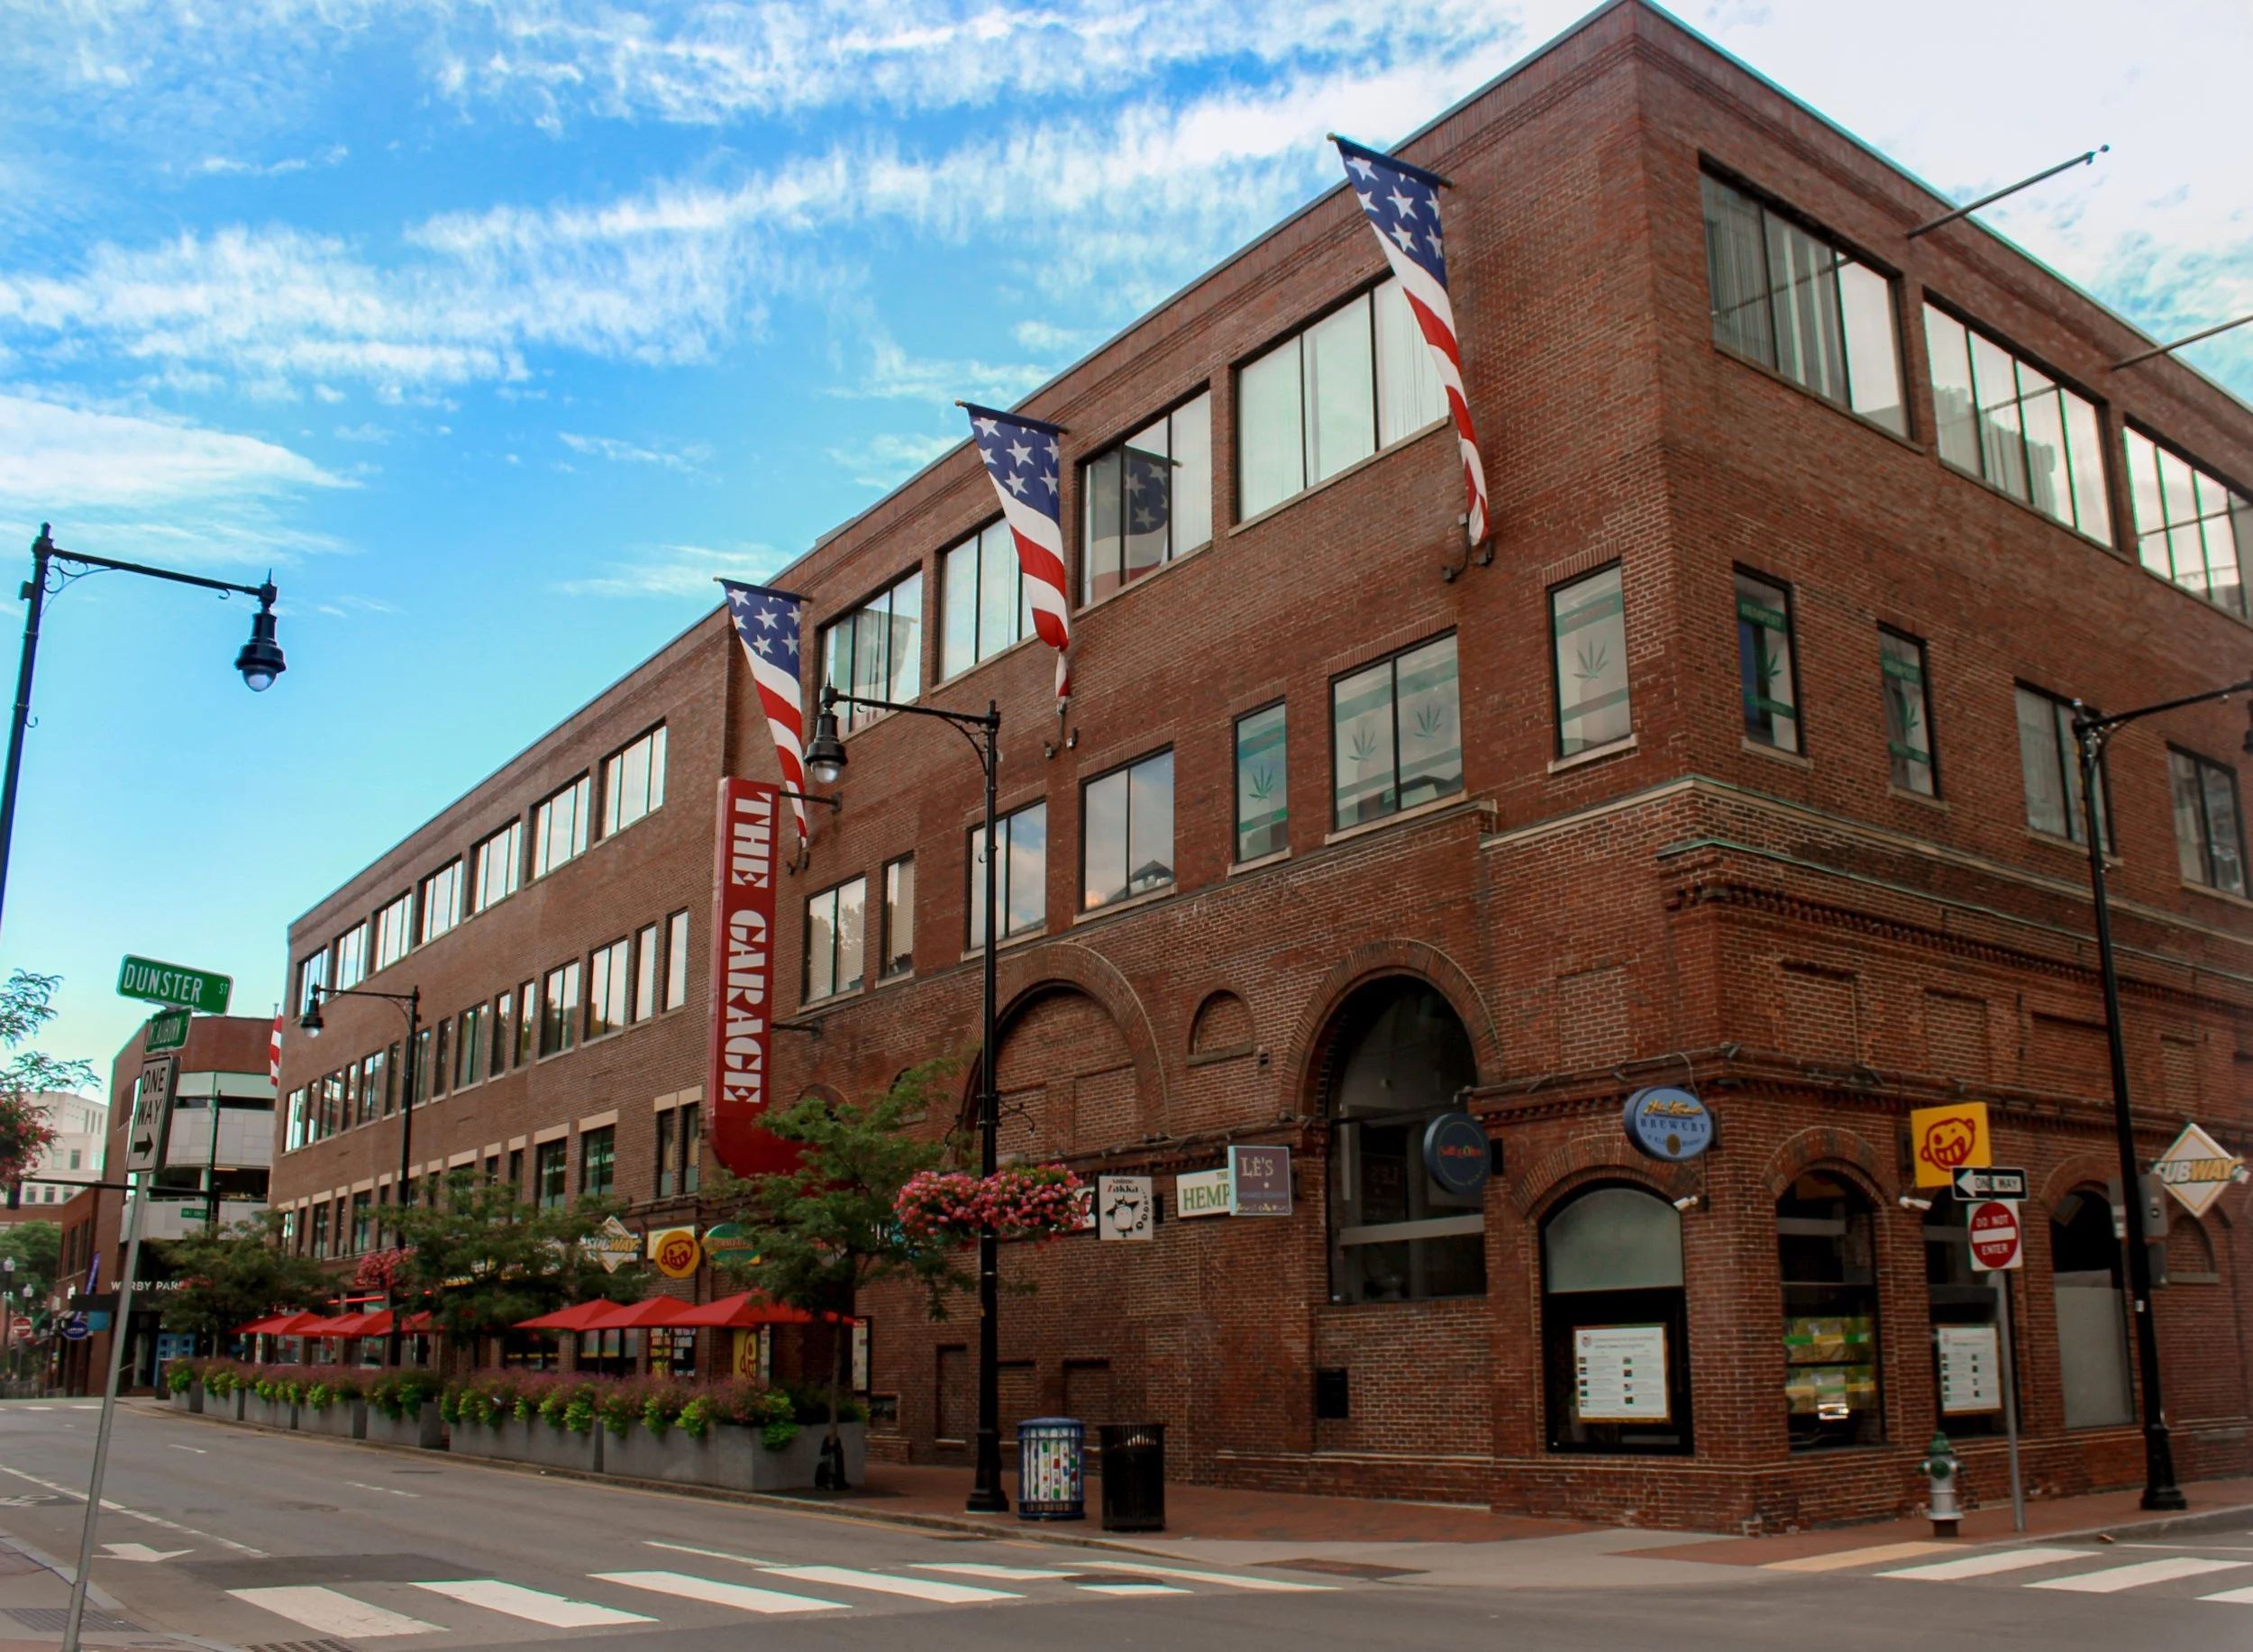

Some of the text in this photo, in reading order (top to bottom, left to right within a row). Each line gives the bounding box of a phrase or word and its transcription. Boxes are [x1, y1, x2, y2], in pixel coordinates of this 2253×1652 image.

[724, 791, 772, 1104] THE GARAGE
[123, 963, 229, 1003] DUNSTER ST
[142, 1067, 167, 1094] ONE
[137, 1099, 166, 1126] WAY
[1640, 1118, 1707, 1133] BREWERY
[2152, 1155, 2245, 1184] SUBWAY
[1999, 1178, 2018, 1189] WAY
[1975, 1214, 2010, 1228] DO NOT
[1981, 1243, 2010, 1255] ENTER
[111, 1281, 152, 1291] WRBY
